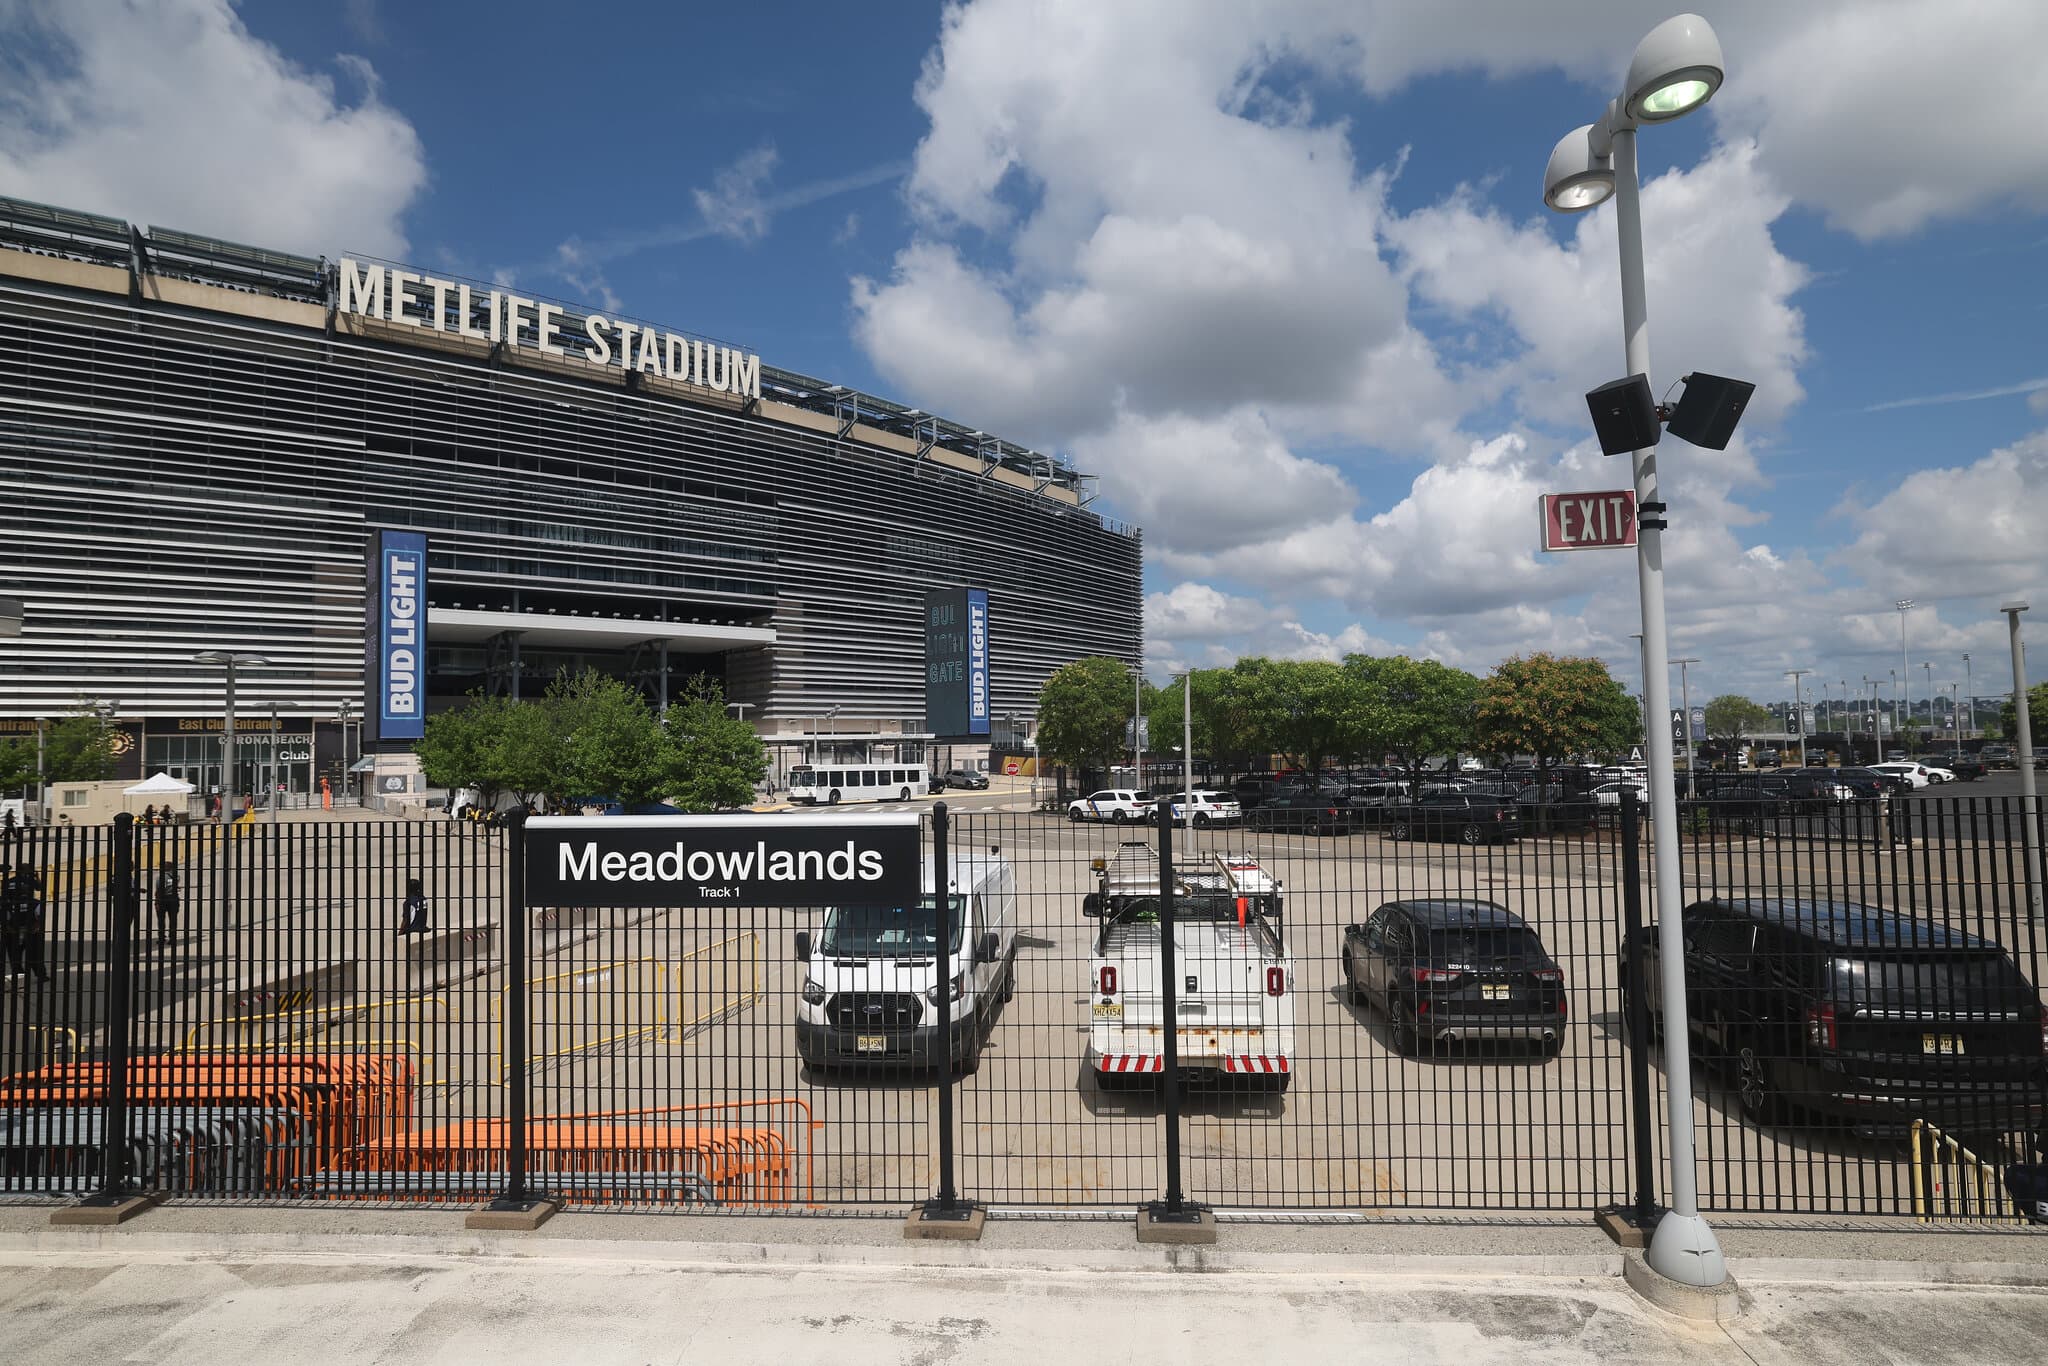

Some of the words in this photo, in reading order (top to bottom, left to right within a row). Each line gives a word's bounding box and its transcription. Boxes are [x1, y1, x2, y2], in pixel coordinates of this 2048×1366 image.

[340, 258, 564, 355] METLIFE
[584, 314, 761, 398] STADIUM
[1559, 498, 1624, 542] EXIT
[390, 556, 416, 645] LIGHT
[972, 606, 985, 668] LIGHT
[390, 649, 415, 713] BUD
[929, 660, 963, 683] GATE
[973, 671, 985, 717] BUD
[179, 719, 203, 730] East
[206, 719, 226, 730] Clu
[234, 719, 282, 730] Entrane
[1673, 712, 1681, 721] A
[1675, 728, 1682, 737] 6
[1790, 725, 1796, 733] 2
[280, 750, 309, 760] Club
[1631, 747, 1642, 760] A
[558, 841, 883, 881] Meadowlands
[699, 887, 731, 898] Track
[734, 887, 740, 898] 1
